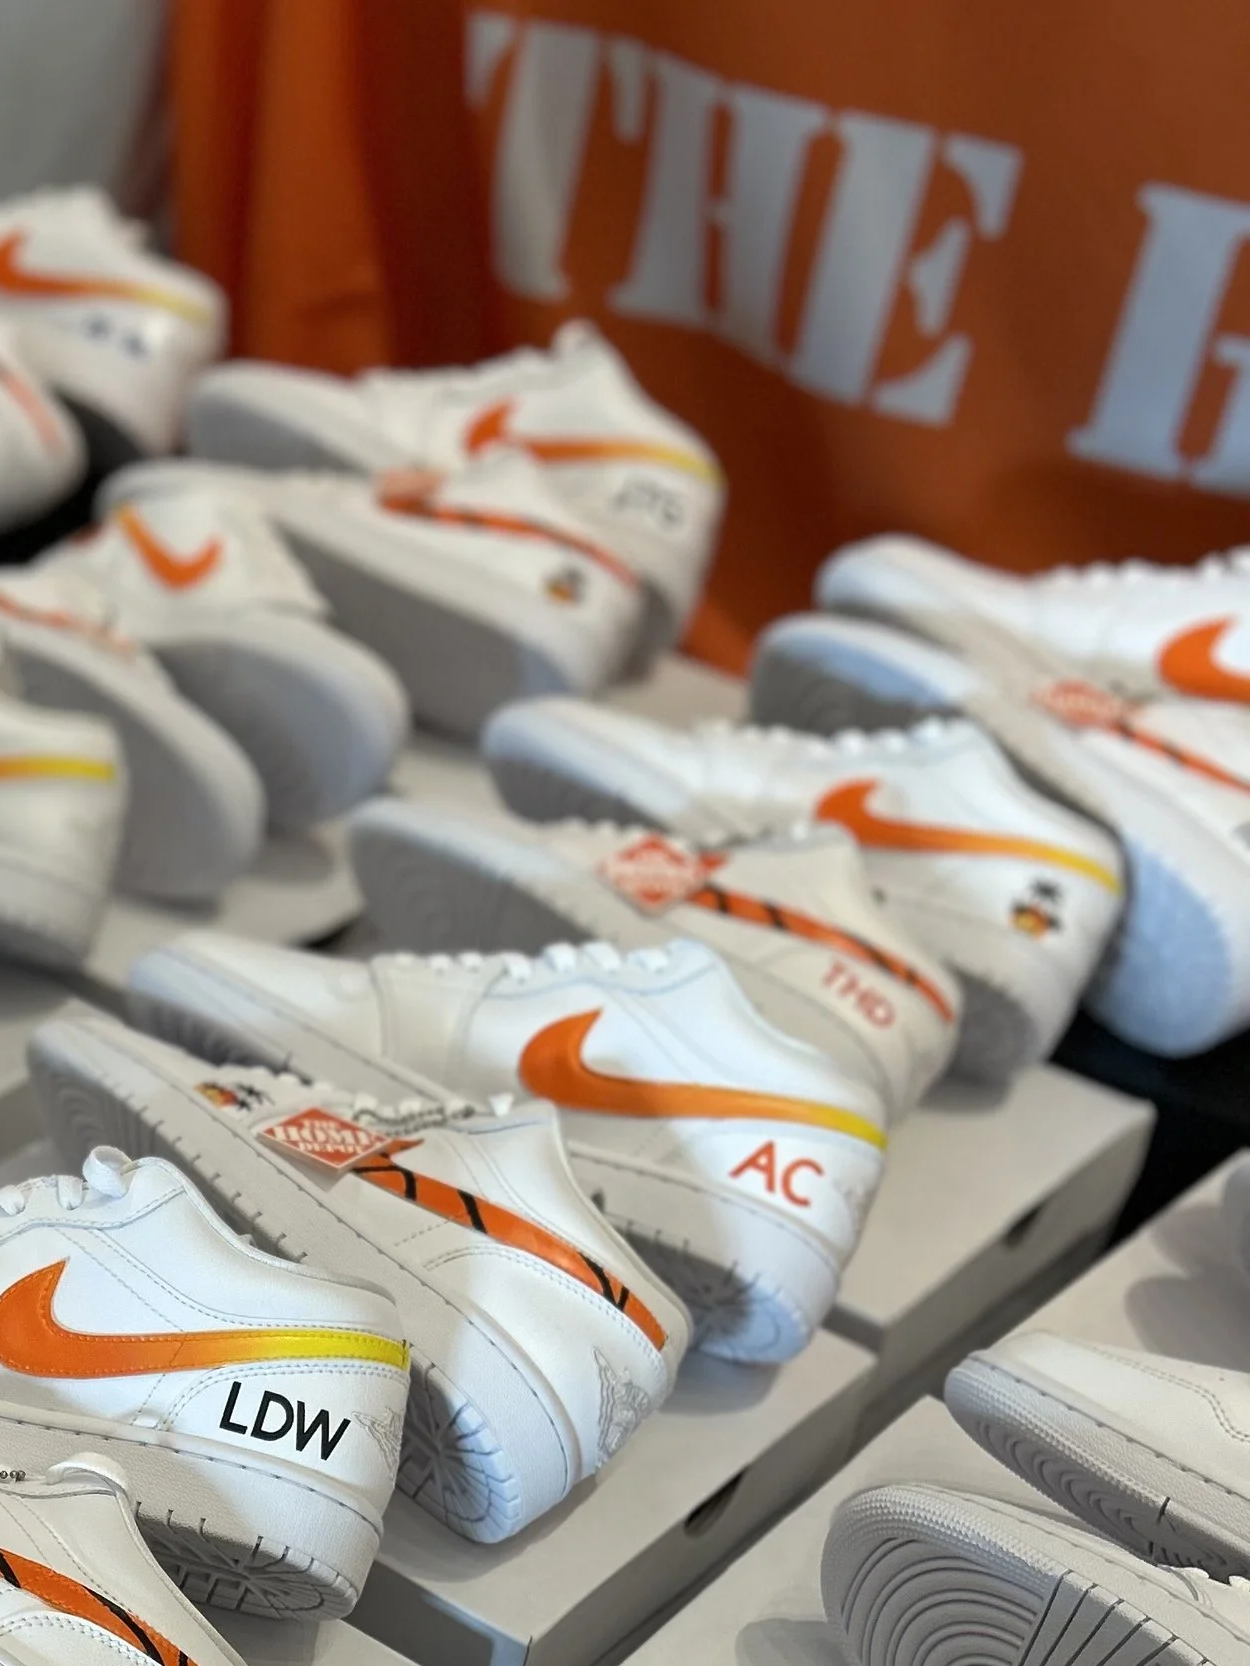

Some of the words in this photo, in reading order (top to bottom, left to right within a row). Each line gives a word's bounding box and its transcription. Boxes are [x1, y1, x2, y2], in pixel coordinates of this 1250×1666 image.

[462, 12, 1023, 428] THE
[820, 961, 897, 1031] THD
[273, 1124, 382, 1148] HOME
[728, 1140, 826, 1208] AC
[219, 1381, 352, 1461] LDW
